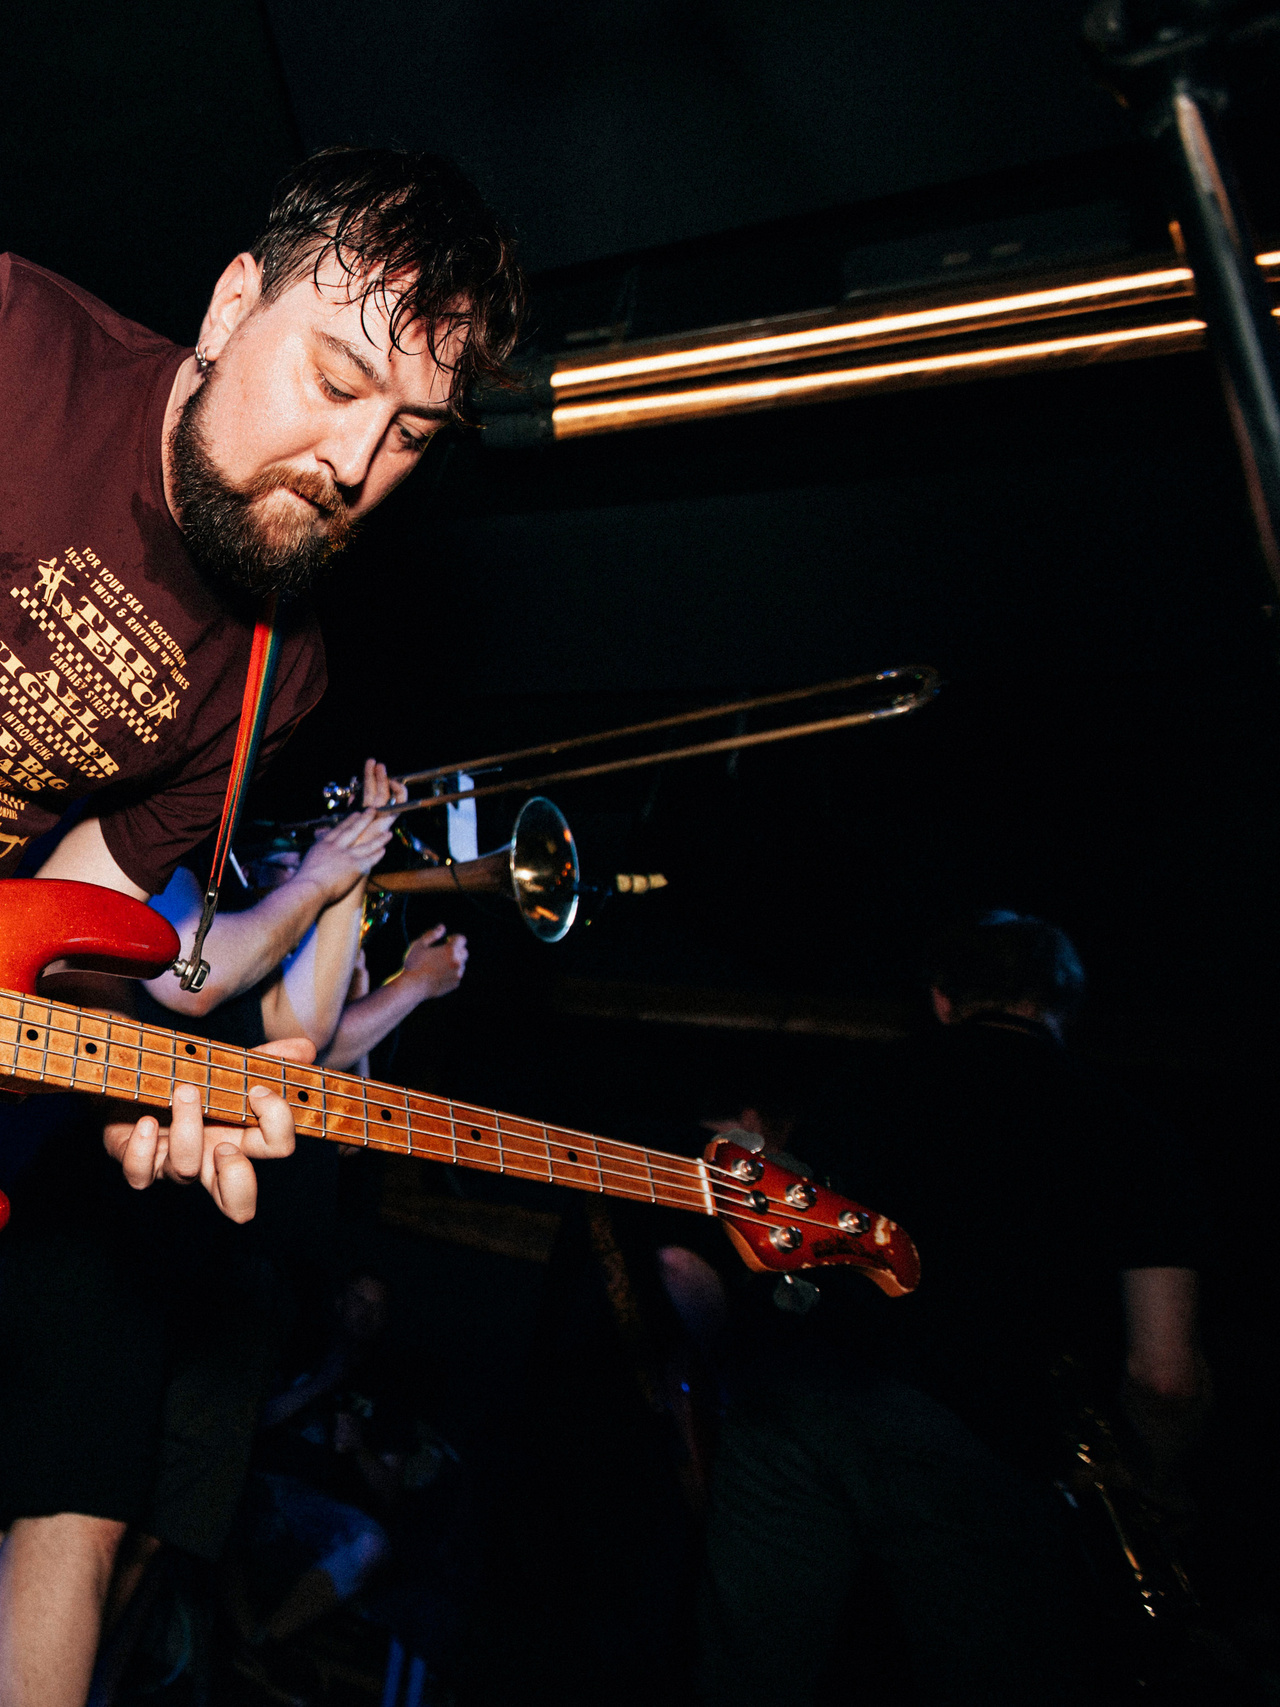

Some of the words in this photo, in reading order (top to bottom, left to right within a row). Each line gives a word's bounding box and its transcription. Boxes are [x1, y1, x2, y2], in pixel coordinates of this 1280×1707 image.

[82, 547, 101, 569] FOR
[98, 567, 125, 594] YOUR
[122, 593, 144, 614] SKA
[52, 593, 157, 707] MERC
[64, 546, 86, 572] JAZZ
[90, 579, 119, 609] TWIST
[116, 608, 128, 618] &
[125, 616, 161, 654] RHYTHM
[170, 667, 190, 690] BLUES
[77, 595, 157, 685] THE
[35, 669, 100, 734] ALL
[49, 652, 88, 690] CARNABY
[85, 690, 114, 720] STREET
[2, 710, 54, 761] INTRODUCING
[18, 753, 70, 790] BIG
